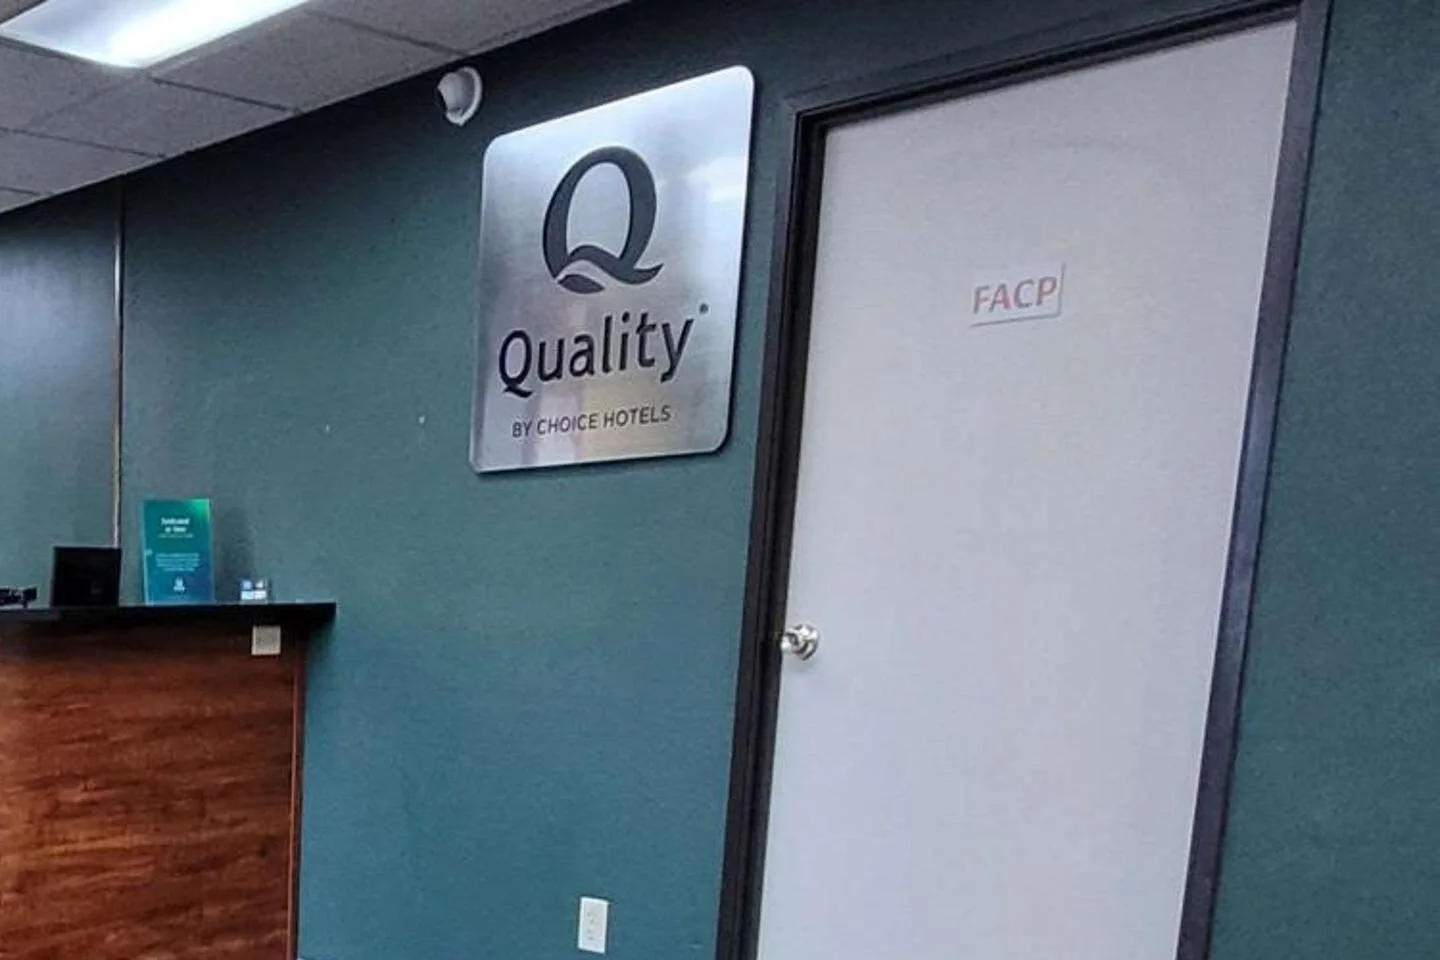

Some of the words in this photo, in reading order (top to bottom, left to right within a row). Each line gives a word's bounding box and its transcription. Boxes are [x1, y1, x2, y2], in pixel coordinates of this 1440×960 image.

[542, 145, 664, 294] Q
[973, 276, 1058, 314] FACP
[498, 311, 695, 398] Quality
[512, 421, 533, 438] BY
[536, 413, 600, 435] CHOICE
[603, 404, 672, 428] HOTELS
